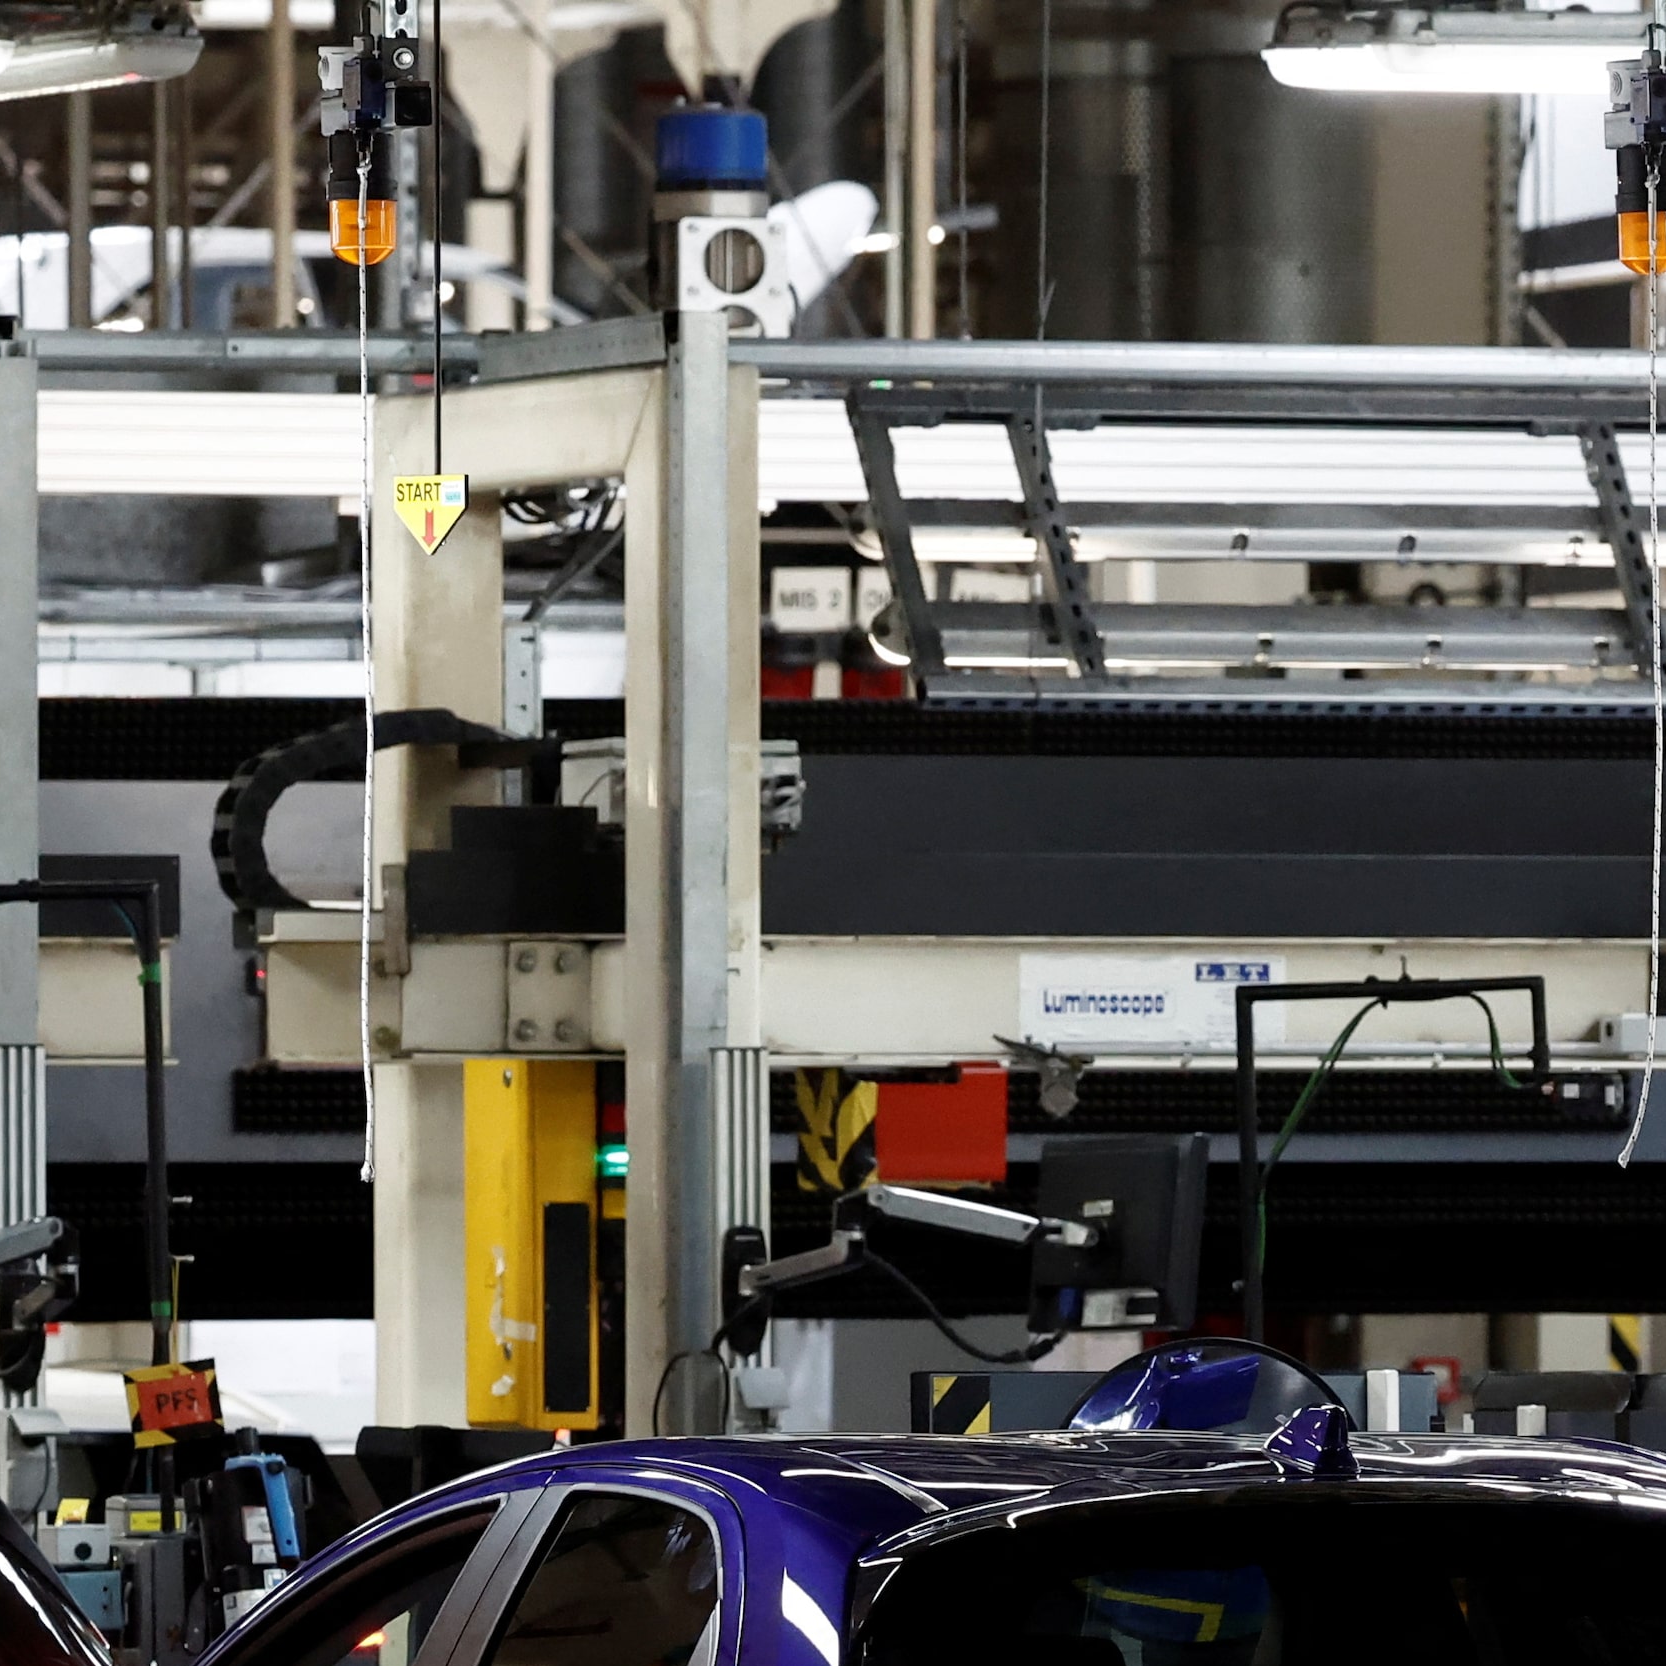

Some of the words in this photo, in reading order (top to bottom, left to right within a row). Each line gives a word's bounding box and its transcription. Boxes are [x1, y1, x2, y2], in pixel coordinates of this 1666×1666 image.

[396, 482, 442, 502] START
[1043, 990, 1165, 1017] Luminoscope
[156, 1387, 197, 1414] PFS
